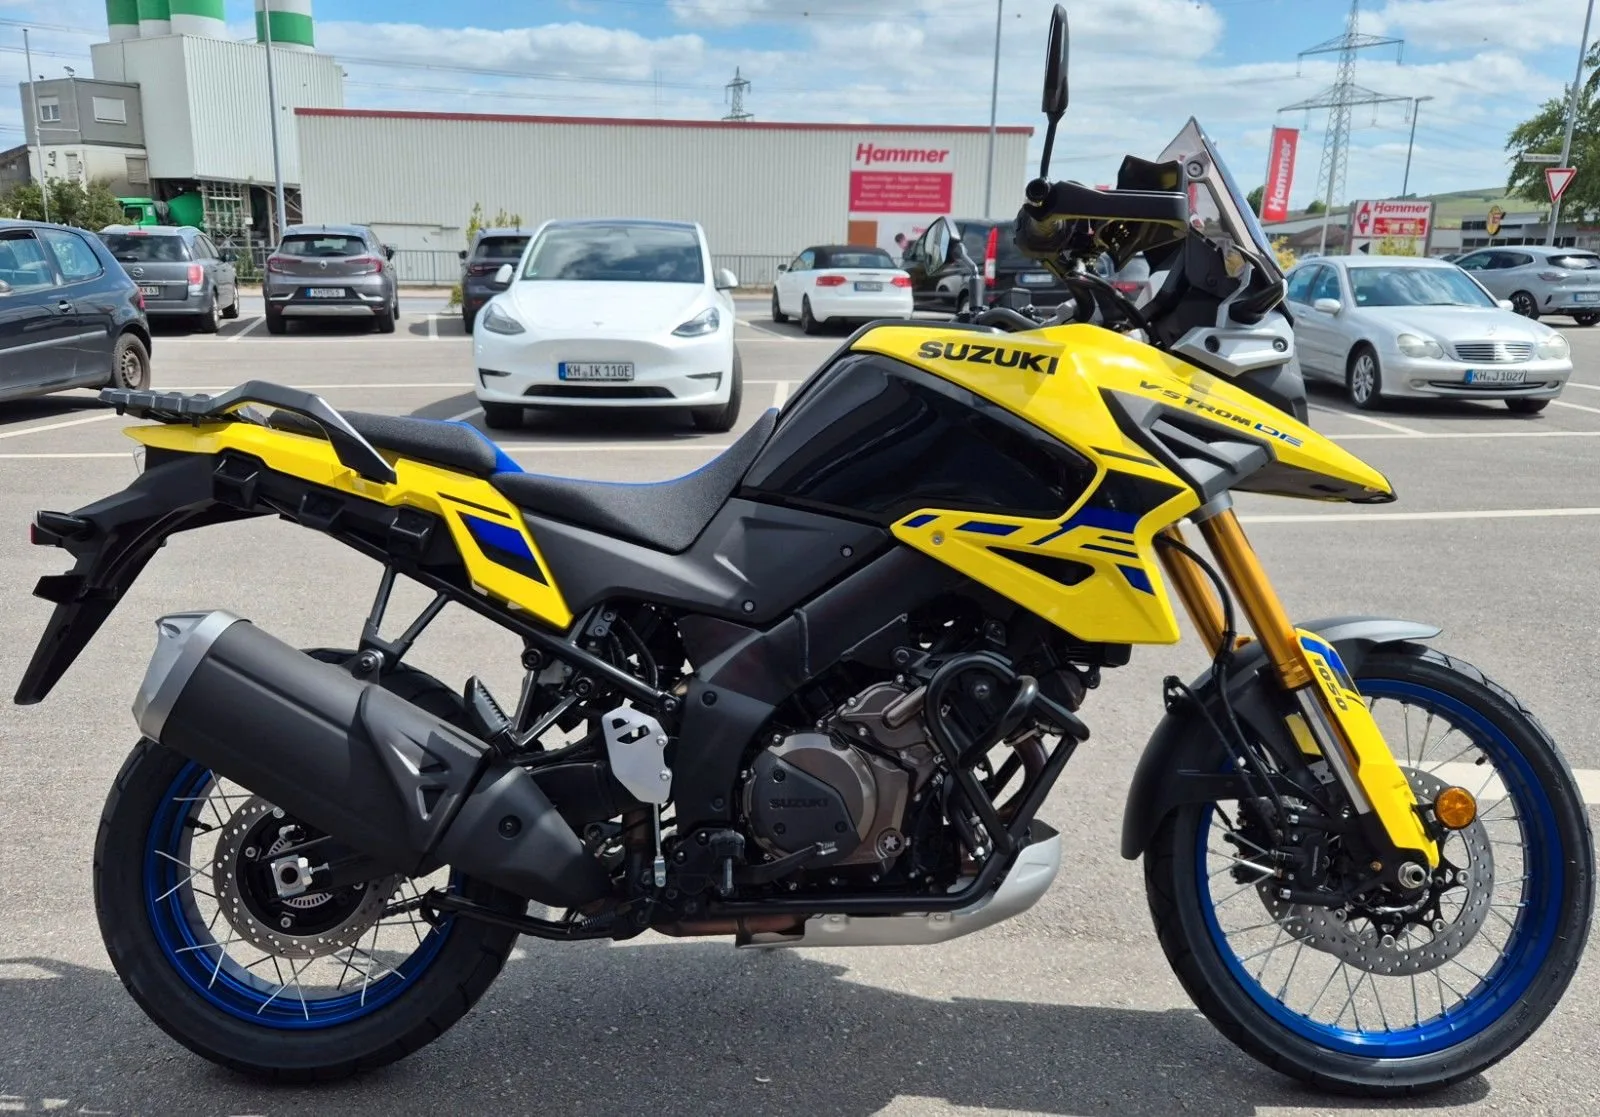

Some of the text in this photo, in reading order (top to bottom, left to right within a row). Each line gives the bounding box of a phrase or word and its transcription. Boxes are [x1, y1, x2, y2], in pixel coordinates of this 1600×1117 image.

[856, 143, 949, 165] Hammer
[1268, 138, 1291, 211] Hammer
[1374, 202, 1429, 214] Hammer
[917, 341, 1060, 375] SUZUKI
[567, 364, 581, 377] KH
[1473, 371, 1487, 381] KH
[1140, 380, 1251, 427] V-STROM
[1312, 659, 1348, 711] 1050
[769, 798, 828, 809] SUZUKI
